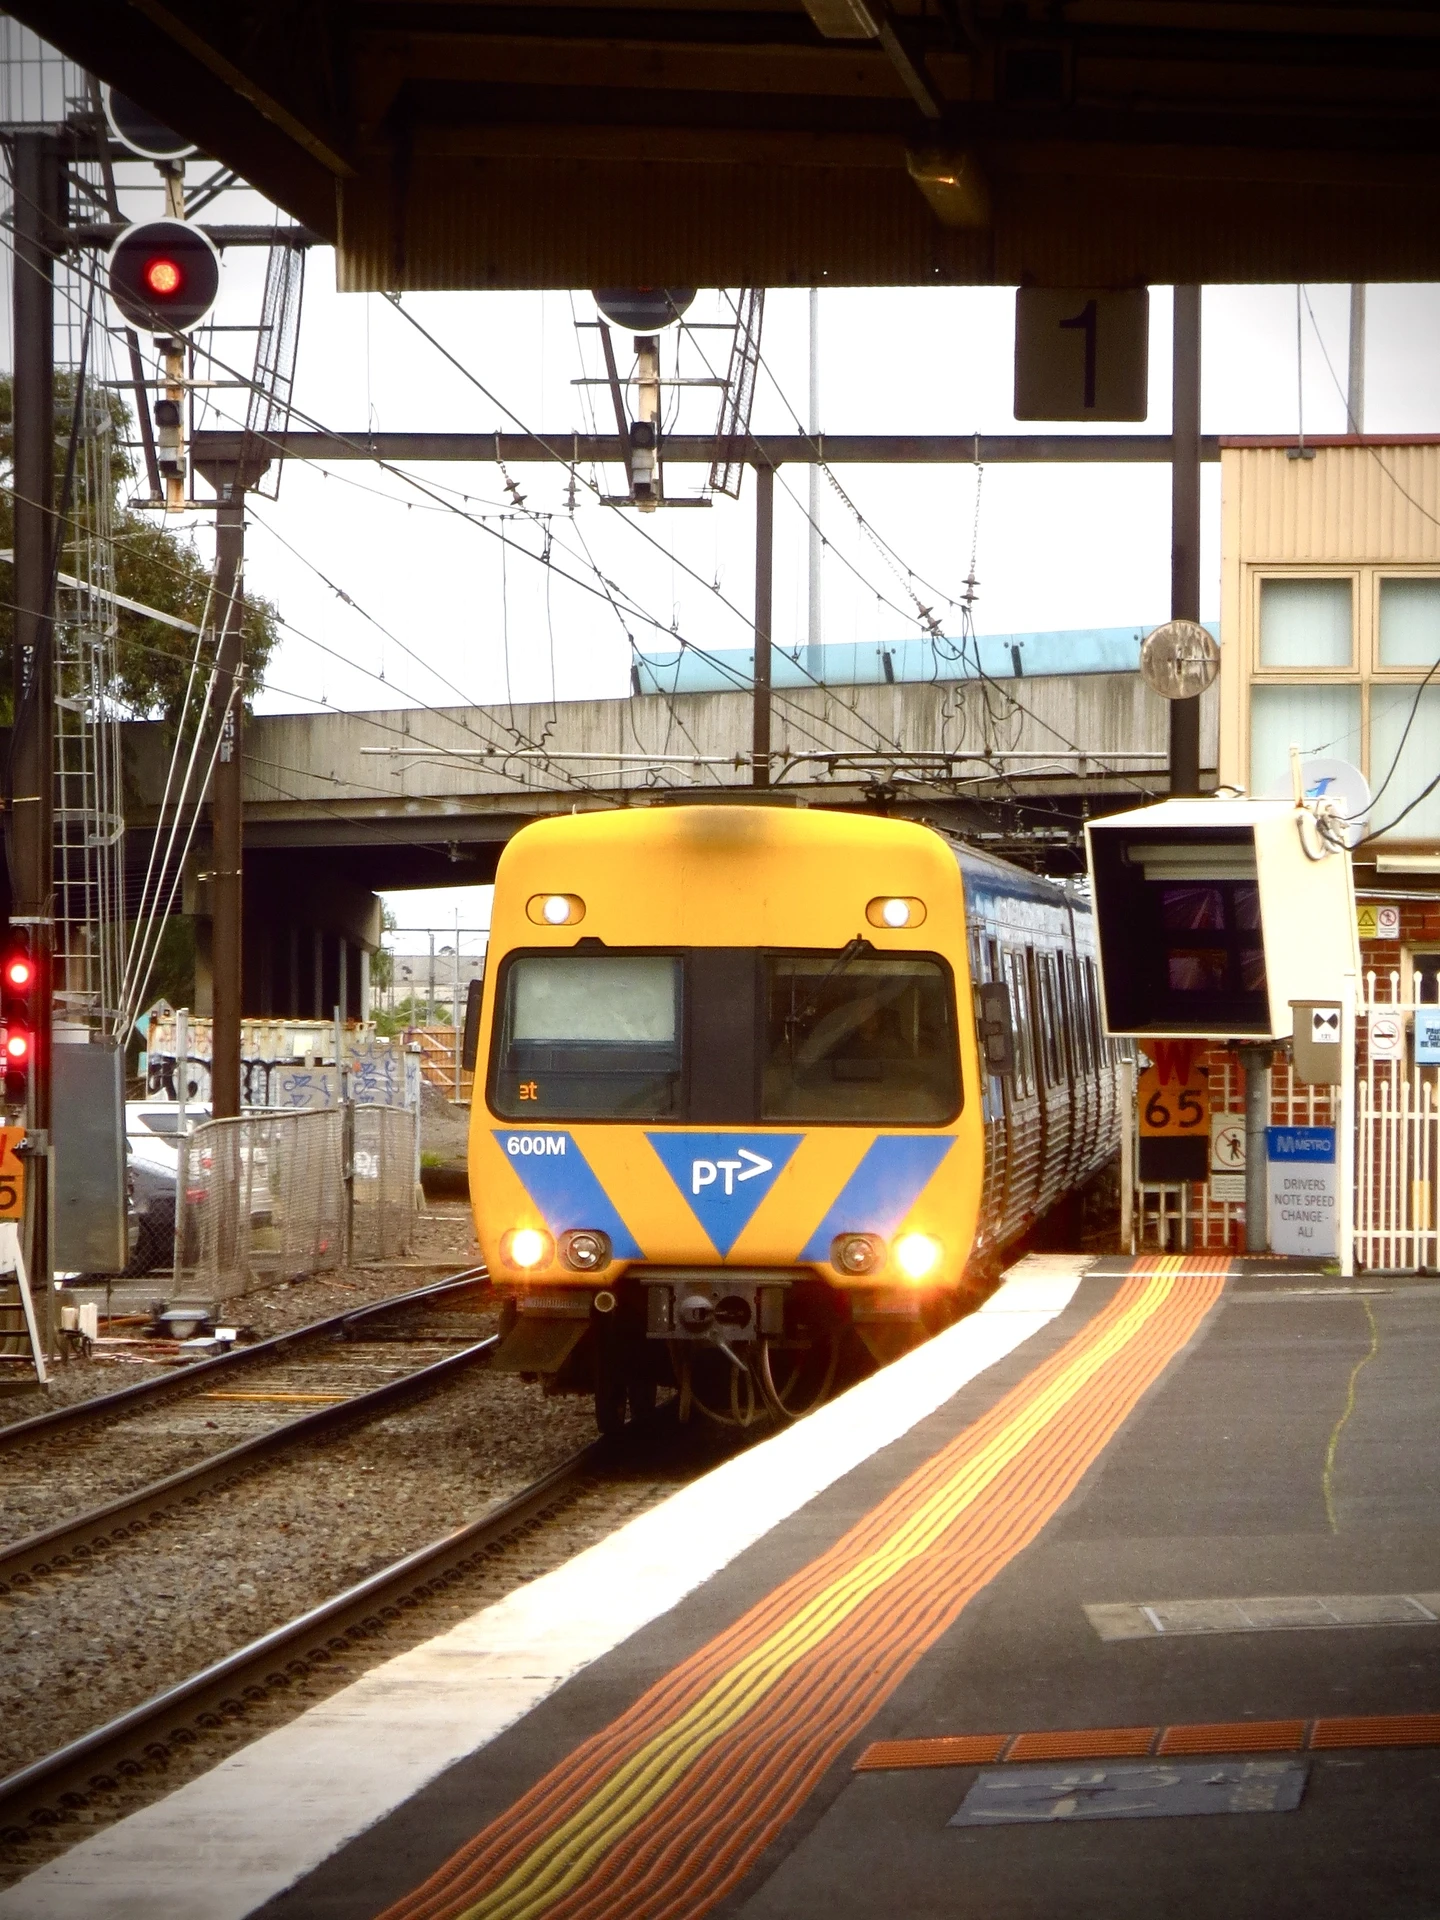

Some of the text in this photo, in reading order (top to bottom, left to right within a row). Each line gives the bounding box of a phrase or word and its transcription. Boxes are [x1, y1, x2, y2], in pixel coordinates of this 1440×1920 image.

[1059, 299, 1097, 408] 1
[1153, 1041, 1192, 1087] W
[1145, 1089, 1204, 1129] 65
[507, 1136, 566, 1155] 600M
[1283, 1178, 1326, 1190] DRIVERS
[1274, 1194, 1335, 1207] NOTE SPEED
[1281, 1210, 1323, 1222] CHANGE
